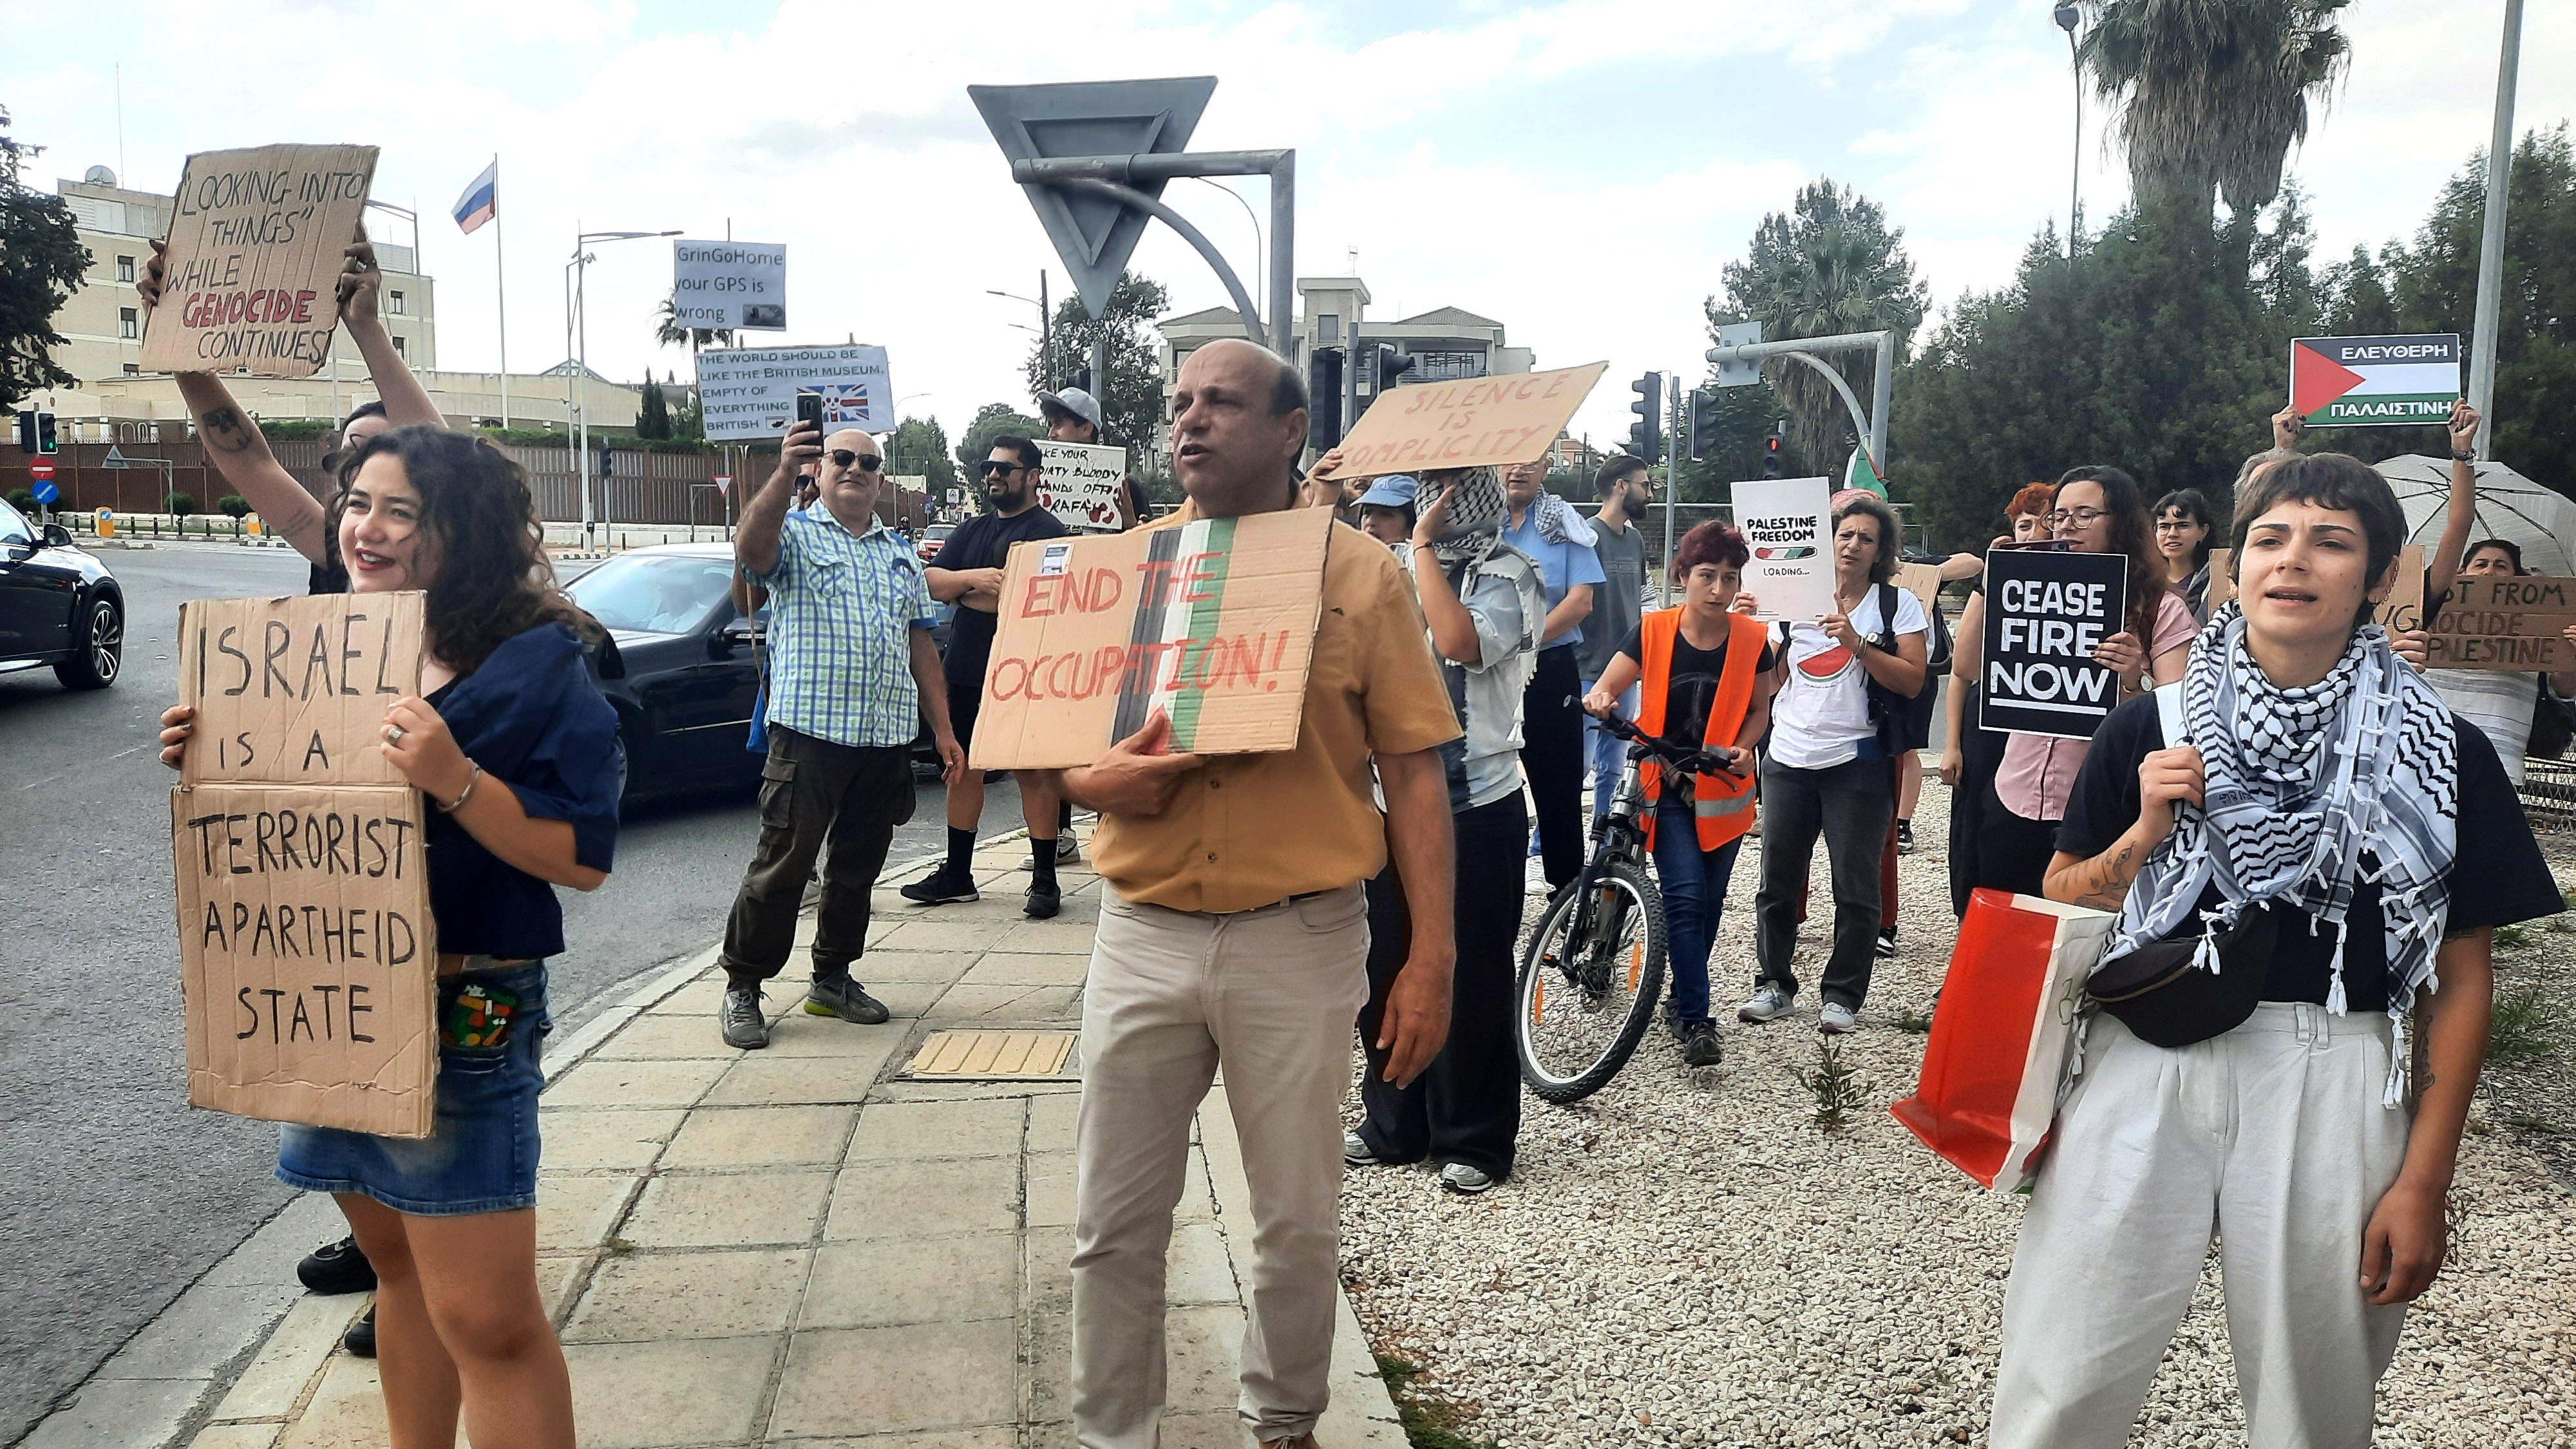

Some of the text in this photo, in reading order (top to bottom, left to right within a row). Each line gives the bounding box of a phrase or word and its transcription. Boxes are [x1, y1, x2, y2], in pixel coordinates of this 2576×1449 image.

[299, 172, 366, 202] INTO
[677, 247, 783, 265] GrinGoHome
[166, 254, 242, 294] WHILE
[675, 276, 764, 292] your GPS is
[183, 289, 317, 328] GENOCIDE
[676, 307, 724, 323] wrong
[197, 330, 327, 365] CONTINUES
[697, 350, 858, 365] THE WORLD SHOULD BE
[2341, 345, 2448, 360] ΕΛΕΥΘΕΡΗ
[700, 371, 730, 381] LIKE
[733, 370, 760, 380] THE
[702, 386, 768, 397] EMPTY OF
[1405, 373, 1571, 415] SILENCE
[704, 401, 790, 415] EVERYTHING
[2331, 401, 2452, 417] ΠΑΛΑΙΣΤΙΝΗ
[706, 420, 759, 431] BRITISH
[1439, 410, 1475, 430] IS
[1061, 450, 1088, 459] YOUR
[1072, 467, 1121, 482] BLOODY
[1747, 516, 1817, 529] PALESTINE
[1752, 528, 1815, 542] FREEDOM
[1021, 551, 1225, 618] END THE
[2492, 583, 2566, 606] FROM
[2002, 580, 2106, 616] CEASE
[2001, 618, 2104, 657] FIRE
[199, 614, 400, 701] ISRAEL
[991, 630, 1289, 702] OCCUPATION!
[1990, 661, 2110, 702] NOW
[220, 729, 329, 771] IS A
[188, 810, 414, 880] TERRORIST
[204, 900, 415, 966] APARTHEID
[237, 984, 375, 1045] STATE
